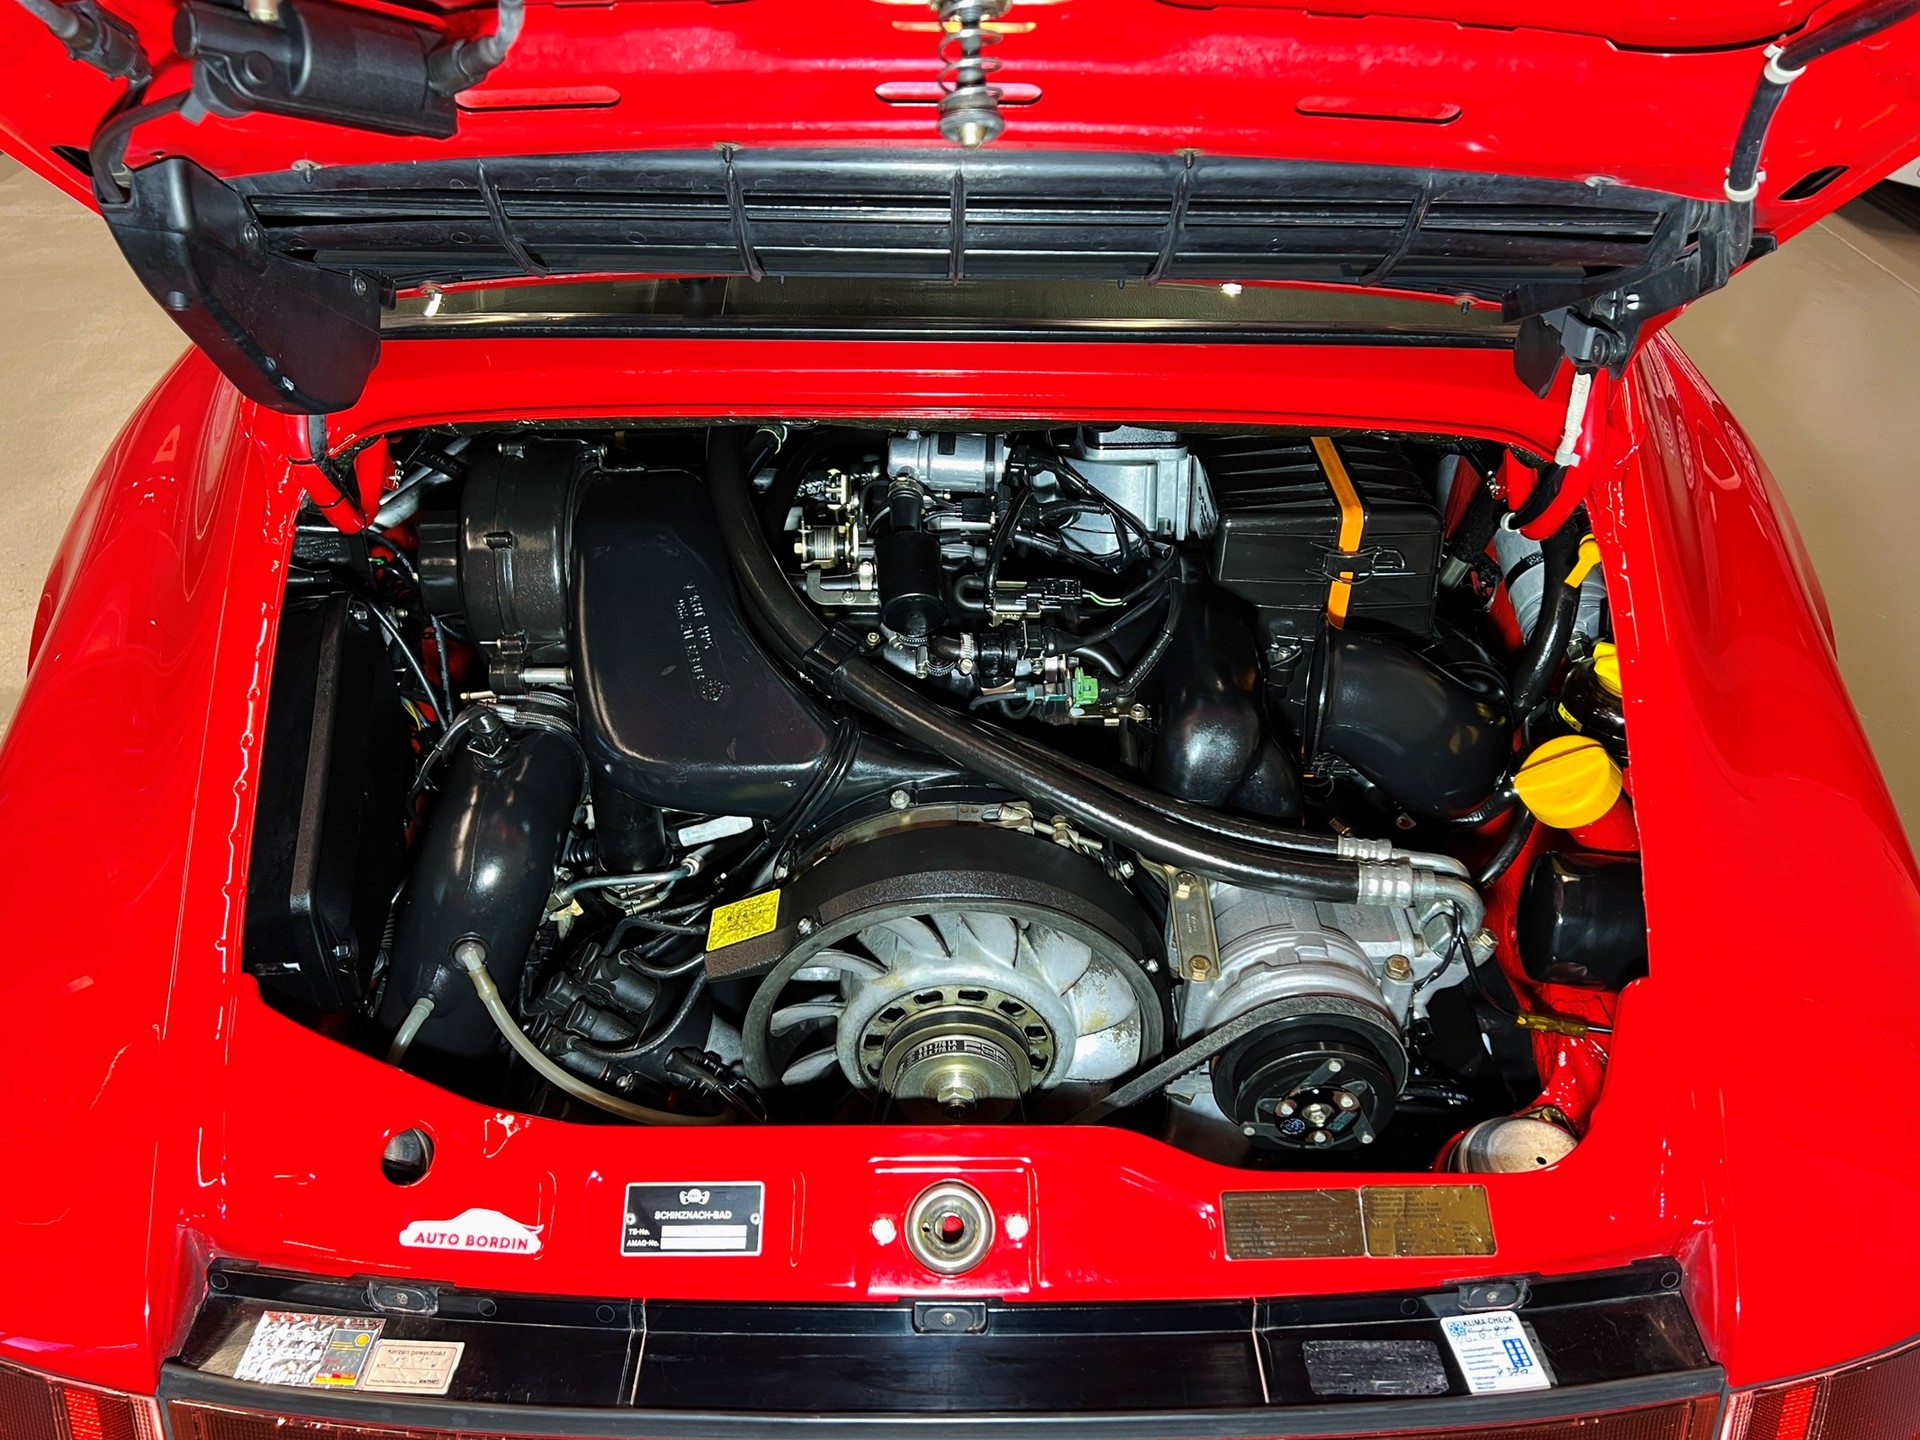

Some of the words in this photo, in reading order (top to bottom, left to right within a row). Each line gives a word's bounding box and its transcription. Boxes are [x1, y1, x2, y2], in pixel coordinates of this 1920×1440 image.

[654, 1210, 733, 1220] SCHINZNACH-BAD
[414, 1231, 460, 1246] AUTO
[465, 1234, 528, 1251] BORDIN
[626, 1239, 659, 1248] AMAG-No.
[1462, 1316, 1514, 1327] KLIMA-CHECK
[387, 1348, 410, 1356] Kerzen
